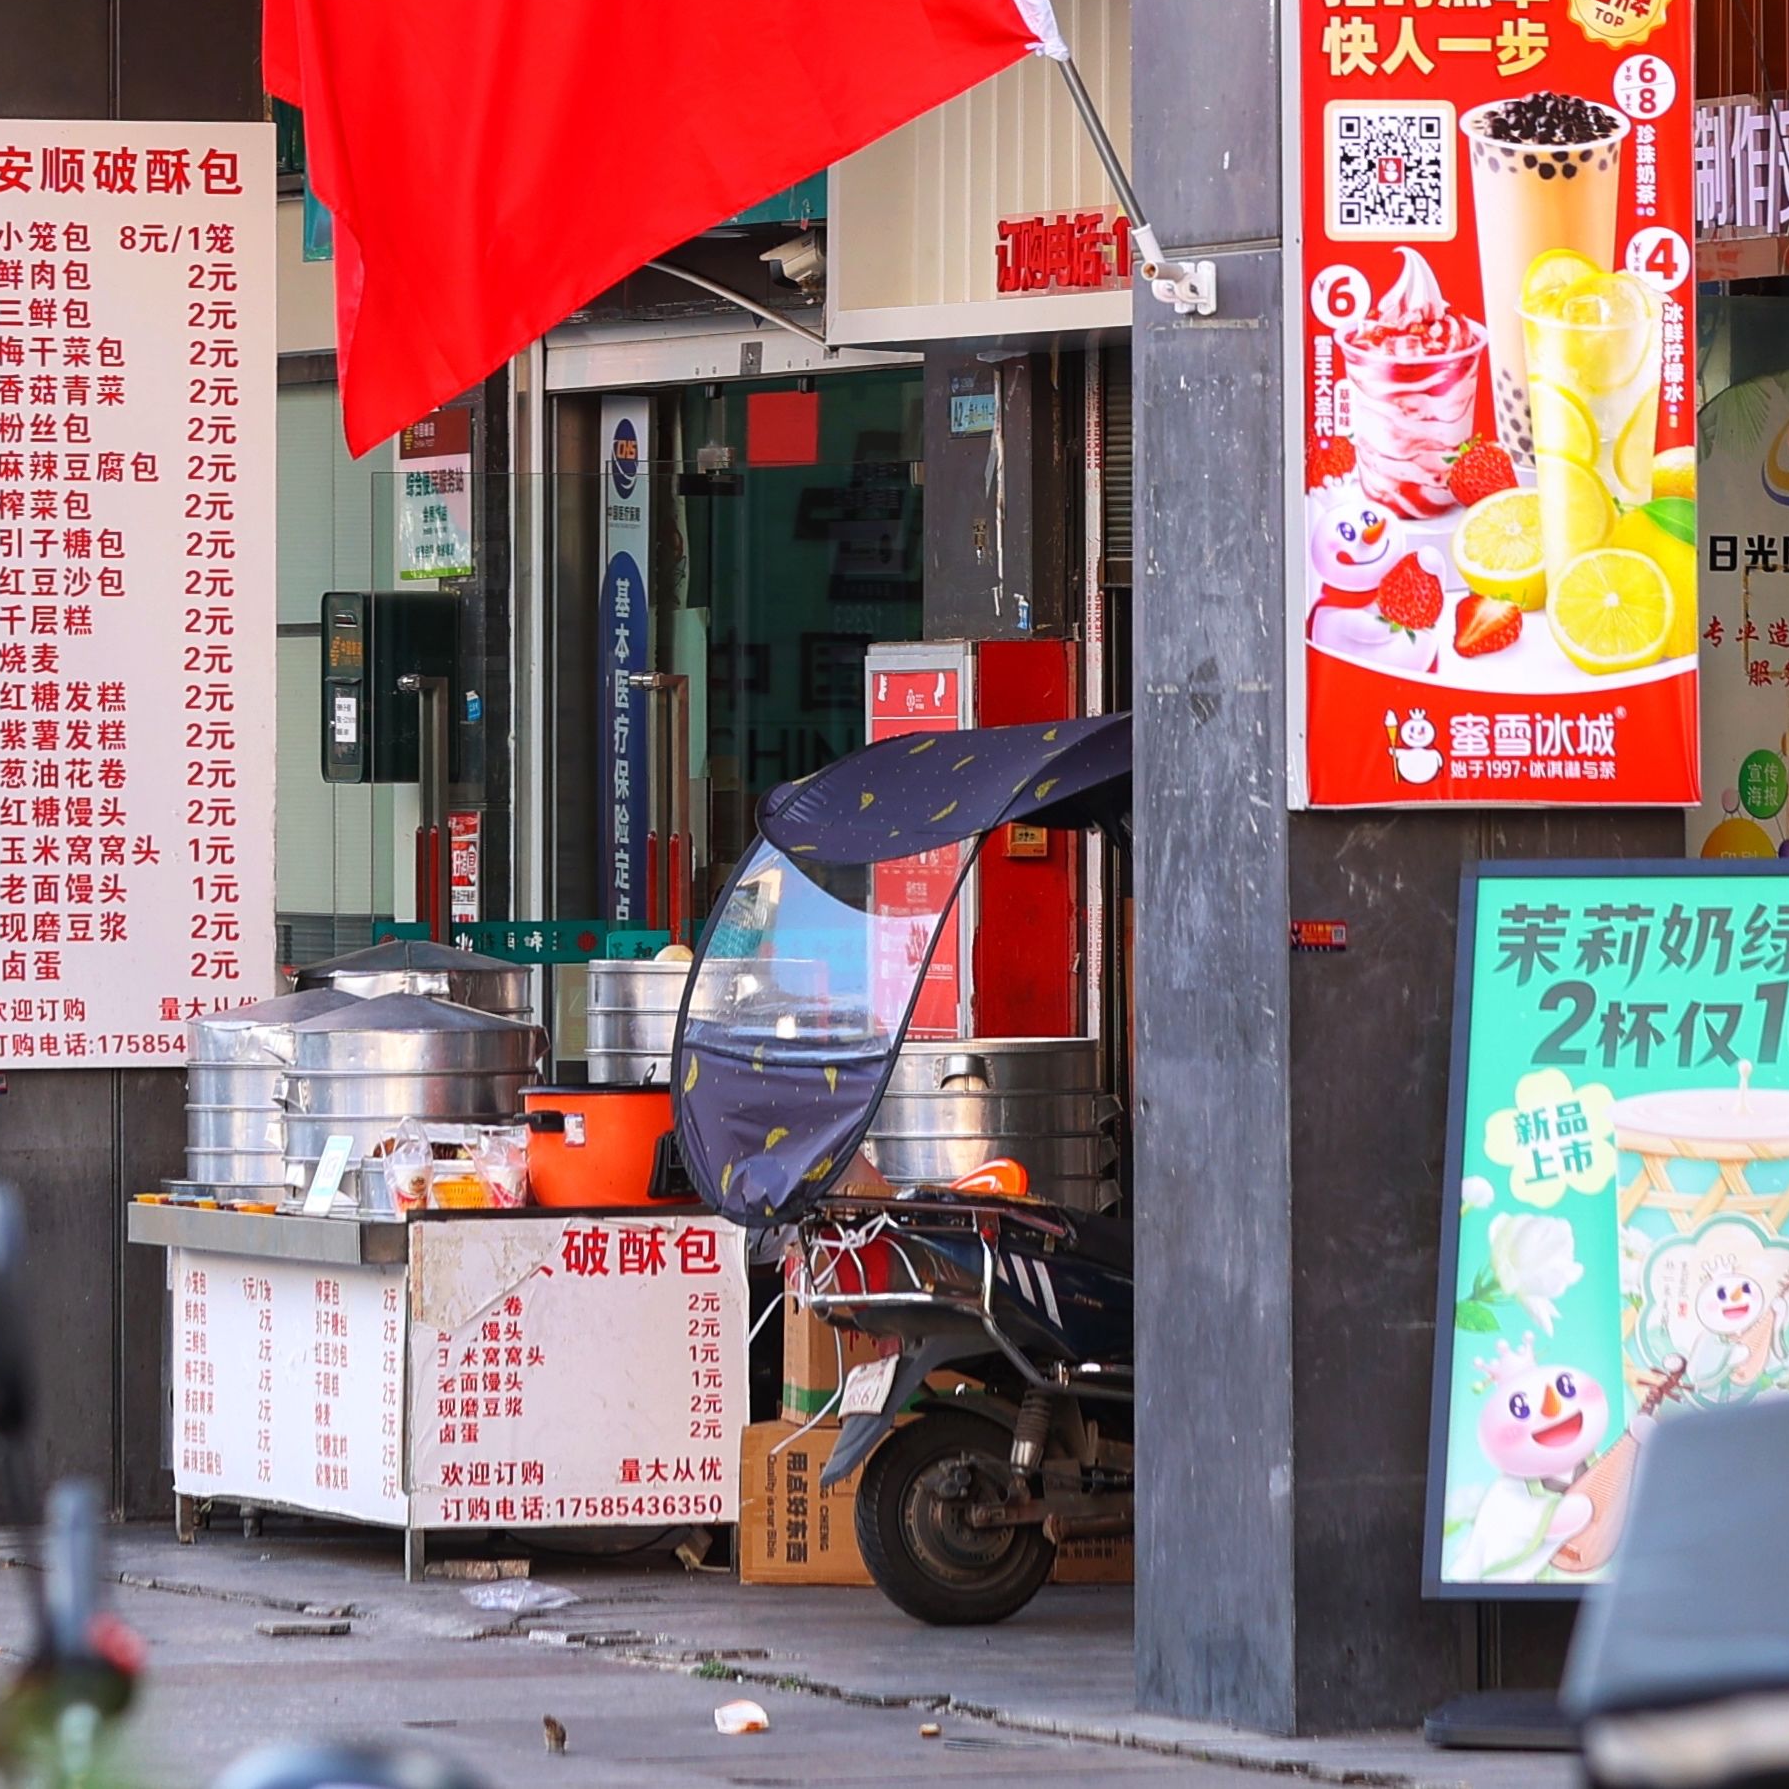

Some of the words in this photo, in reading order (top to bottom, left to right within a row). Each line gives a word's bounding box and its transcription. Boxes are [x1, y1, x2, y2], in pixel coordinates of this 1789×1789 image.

[1594, 7, 1625, 28] TOP
[1322, 16, 1550, 77] 快人一步
[1635, 123, 1657, 206] 珍珠奶茶
[118, 222, 236, 255] 8元/1笼
[187, 262, 239, 293] 2元
[187, 301, 238, 331] 2元
[189, 339, 239, 369] 2元
[1663, 302, 1686, 404] 冰鲜柠檬水
[189, 377, 239, 407] 2元
[1314, 335, 1334, 438] 雪王大圣代
[187, 415, 238, 445] 2元
[187, 453, 238, 483] 2元
[184, 492, 235, 522] 2元
[185, 530, 236, 560] 2元
[184, 568, 235, 598] 2元
[184, 606, 235, 636] 2元
[183, 645, 234, 675] 2元
[0, 681, 127, 713] 红糖发糕
[185, 683, 235, 713] 2元
[0, 719, 127, 751] 紫薯发糕
[185, 721, 236, 751] 2元
[1450, 712, 1617, 758] 蜜雪冰城
[0, 758, 127, 790] 葱油花卷
[186, 759, 237, 790] 2元
[1746, 762, 1779, 785] 宣传
[0, 796, 127, 828] 红糖馒头
[186, 797, 237, 828] 2元
[1746, 786, 1779, 808] 海报
[0, 834, 160, 866] 玉米窝窝头
[189, 836, 236, 866] 1元
[0, 873, 128, 905] 老面馒头
[192, 874, 240, 904] 1元
[0, 911, 128, 943] 现磨豆浆
[191, 912, 240, 942] 2元
[1, 950, 62, 982] 卤蛋
[191, 950, 240, 980] 2元
[1513, 1101, 1589, 1141] 新品
[1524, 1150, 1594, 1186] 上市
[529, 1225, 722, 1278] 破酥包
[383, 1288, 397, 1312] 2元
[688, 1293, 722, 1314] 2元
[259, 1309, 272, 1332] 2元
[383, 1320, 397, 1344] 2元
[688, 1319, 721, 1339] 2元
[258, 1339, 272, 1362] 2元
[383, 1351, 396, 1375] 2元
[689, 1343, 721, 1364] 1元
[258, 1370, 272, 1393] 2元
[691, 1368, 723, 1389] 1元
[383, 1382, 396, 1406] 2元
[438, 1397, 524, 1418] 现磨豆浆
[690, 1394, 723, 1415] 2元
[258, 1400, 272, 1423] 2元
[382, 1413, 396, 1437] 2元
[257, 1430, 271, 1453] 2元
[439, 1422, 479, 1444] 卤蛋
[690, 1420, 723, 1440] 2元
[257, 1459, 271, 1483] 2元
[382, 1444, 396, 1468] 2元
[383, 1475, 397, 1499] 2元
[440, 1462, 545, 1487] 欢迎订购
[619, 1458, 723, 1484] 量大从优
[441, 1494, 723, 1522] 订购电话:17585436350
